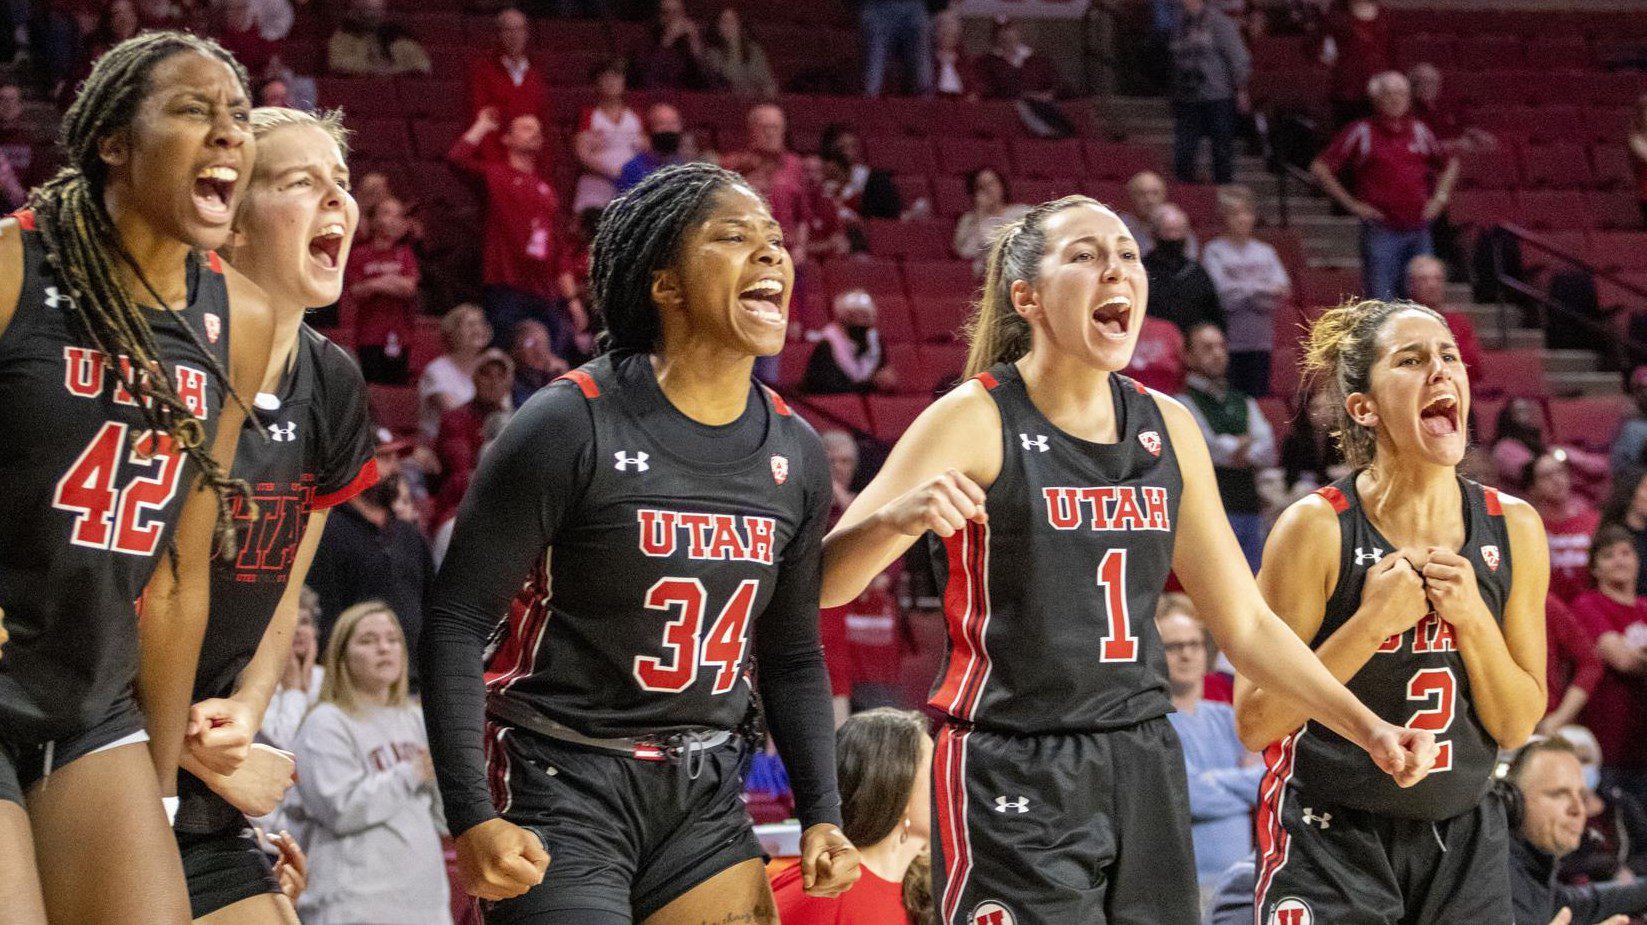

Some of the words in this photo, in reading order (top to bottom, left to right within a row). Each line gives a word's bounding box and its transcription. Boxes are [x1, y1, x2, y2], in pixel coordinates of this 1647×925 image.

[52, 421, 188, 556] 42
[637, 509, 776, 566] UTAH
[1042, 482, 1171, 532] UTAH
[633, 576, 760, 695] 34
[1097, 548, 1139, 662] 1
[1405, 667, 1456, 774] 2
